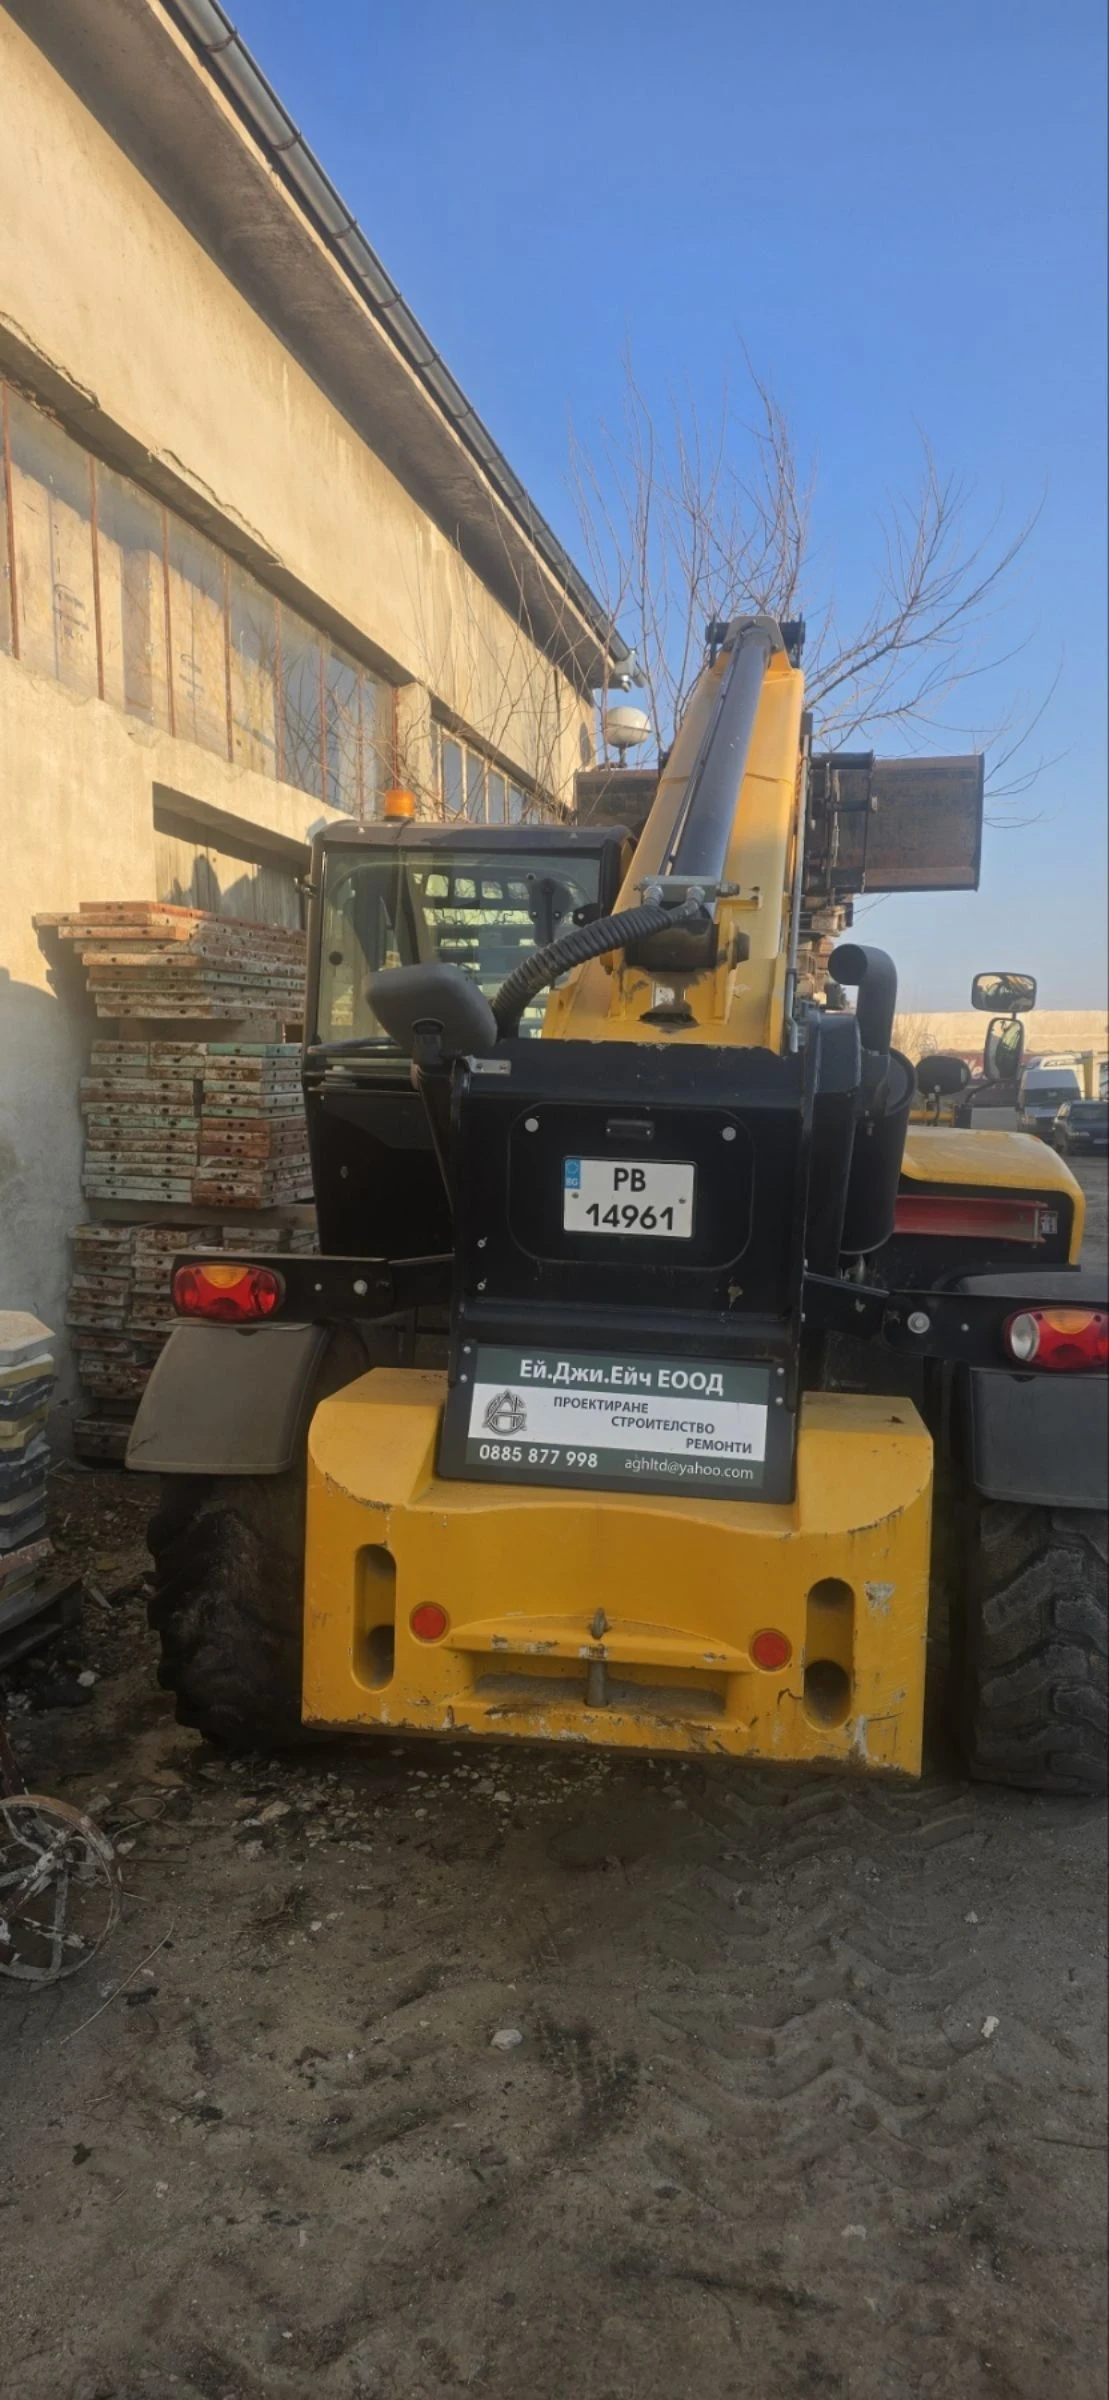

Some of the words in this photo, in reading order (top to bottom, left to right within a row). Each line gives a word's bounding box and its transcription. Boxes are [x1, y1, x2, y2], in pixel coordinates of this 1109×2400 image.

[565, 1178, 578, 1186] BG
[613, 1167, 646, 1192] PB
[585, 1203, 674, 1231] 14961
[520, 1358, 652, 1387] Ей.Джи.Ейч
[658, 1368, 724, 1397] ЕООД
[553, 1396, 649, 1414] ПРОЕКТИРАНЕ
[611, 1415, 715, 1435] СТРОИТЕЛСТВО
[686, 1437, 753, 1454] РЕМОНТИ
[479, 1444, 522, 1462] 0885
[528, 1447, 560, 1464] 877
[566, 1451, 598, 1468] 998
[624, 1456, 753, 1480] aghltd@yahoo.com
